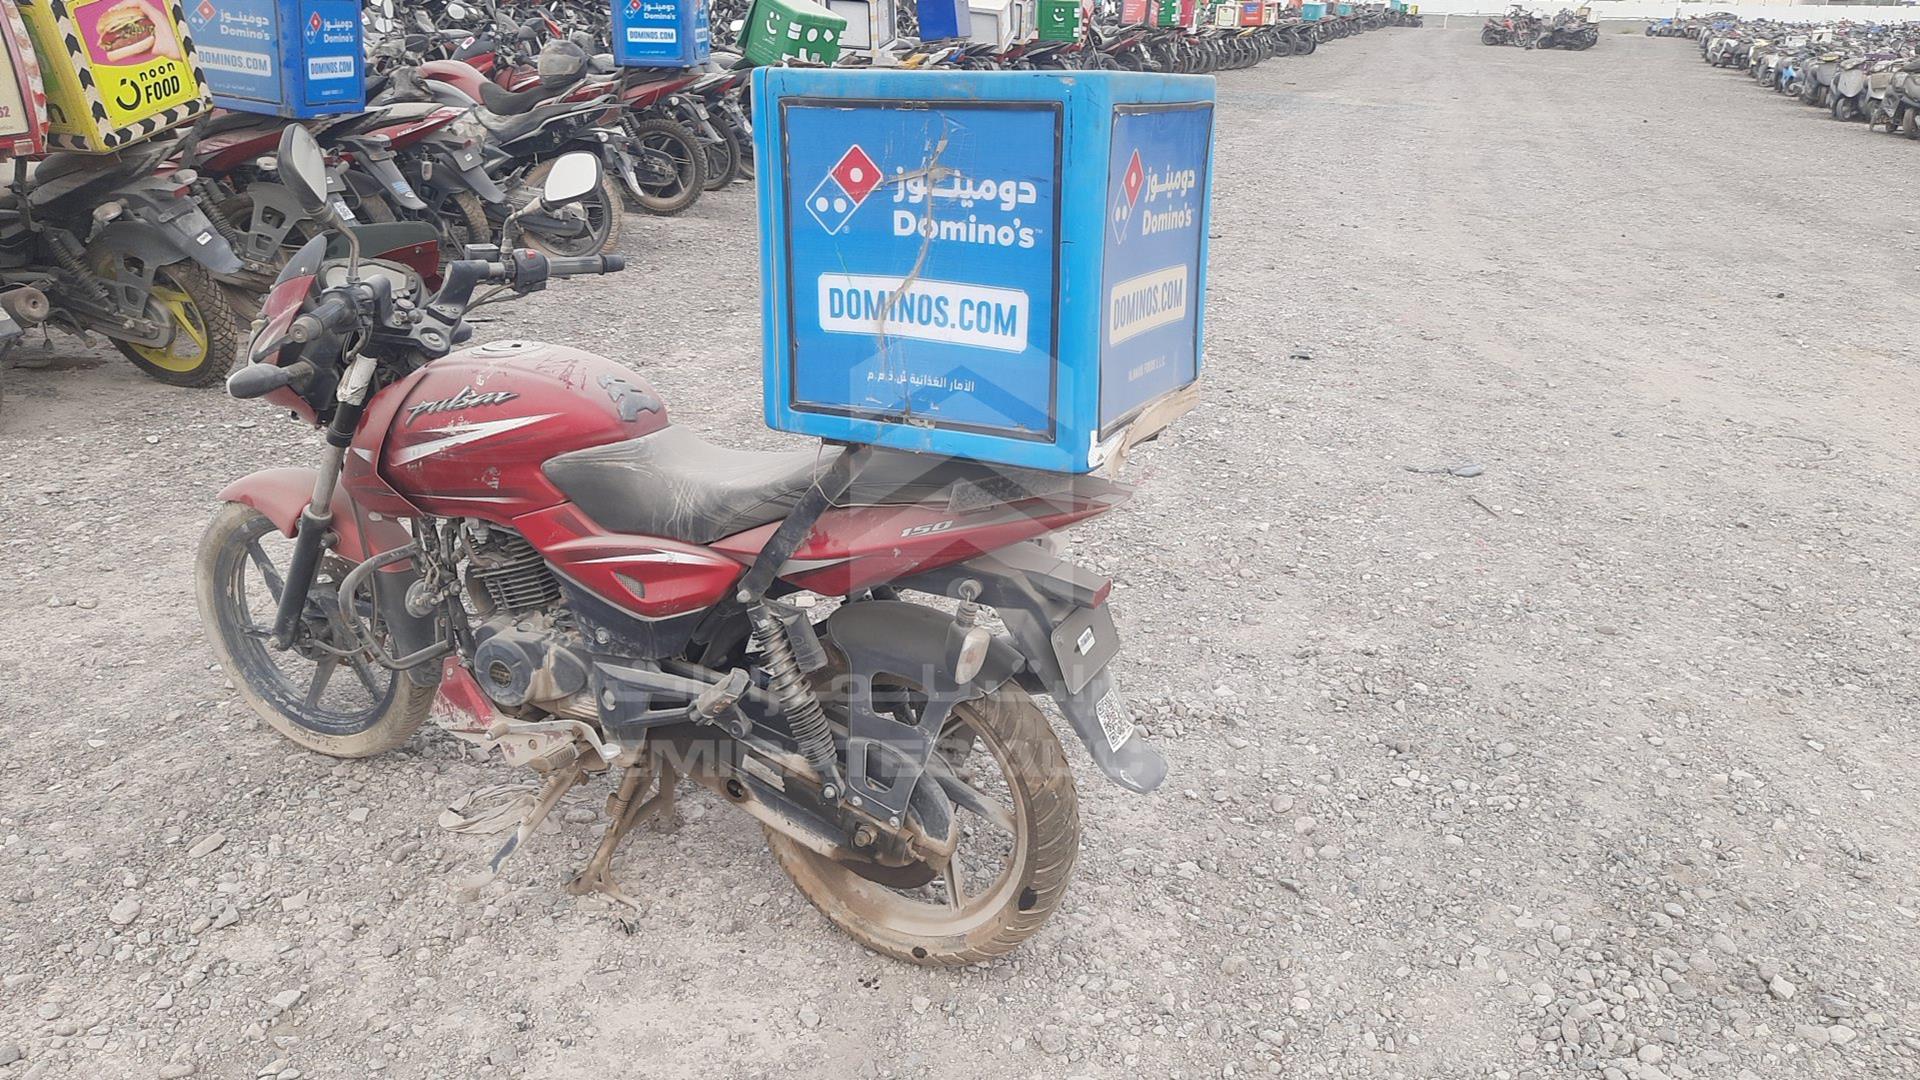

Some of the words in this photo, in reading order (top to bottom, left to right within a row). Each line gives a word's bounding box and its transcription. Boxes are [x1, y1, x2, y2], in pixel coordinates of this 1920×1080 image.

[220, 25, 271, 41] Domino's
[324, 33, 354, 44] Domino's
[629, 30, 674, 40] DOMINOS.COM
[198, 50, 268, 72] DOMINOS.COM
[311, 60, 352, 76] DOMINOS.COM
[139, 62, 176, 82] noon
[145, 75, 180, 104] FOOD
[893, 209, 1035, 249] Domino's
[1142, 203, 1193, 236] Domino's
[829, 286, 1018, 338] DOMINOS.COM
[1112, 281, 1183, 332] DOMINOS.COM
[900, 519, 953, 538] 150
